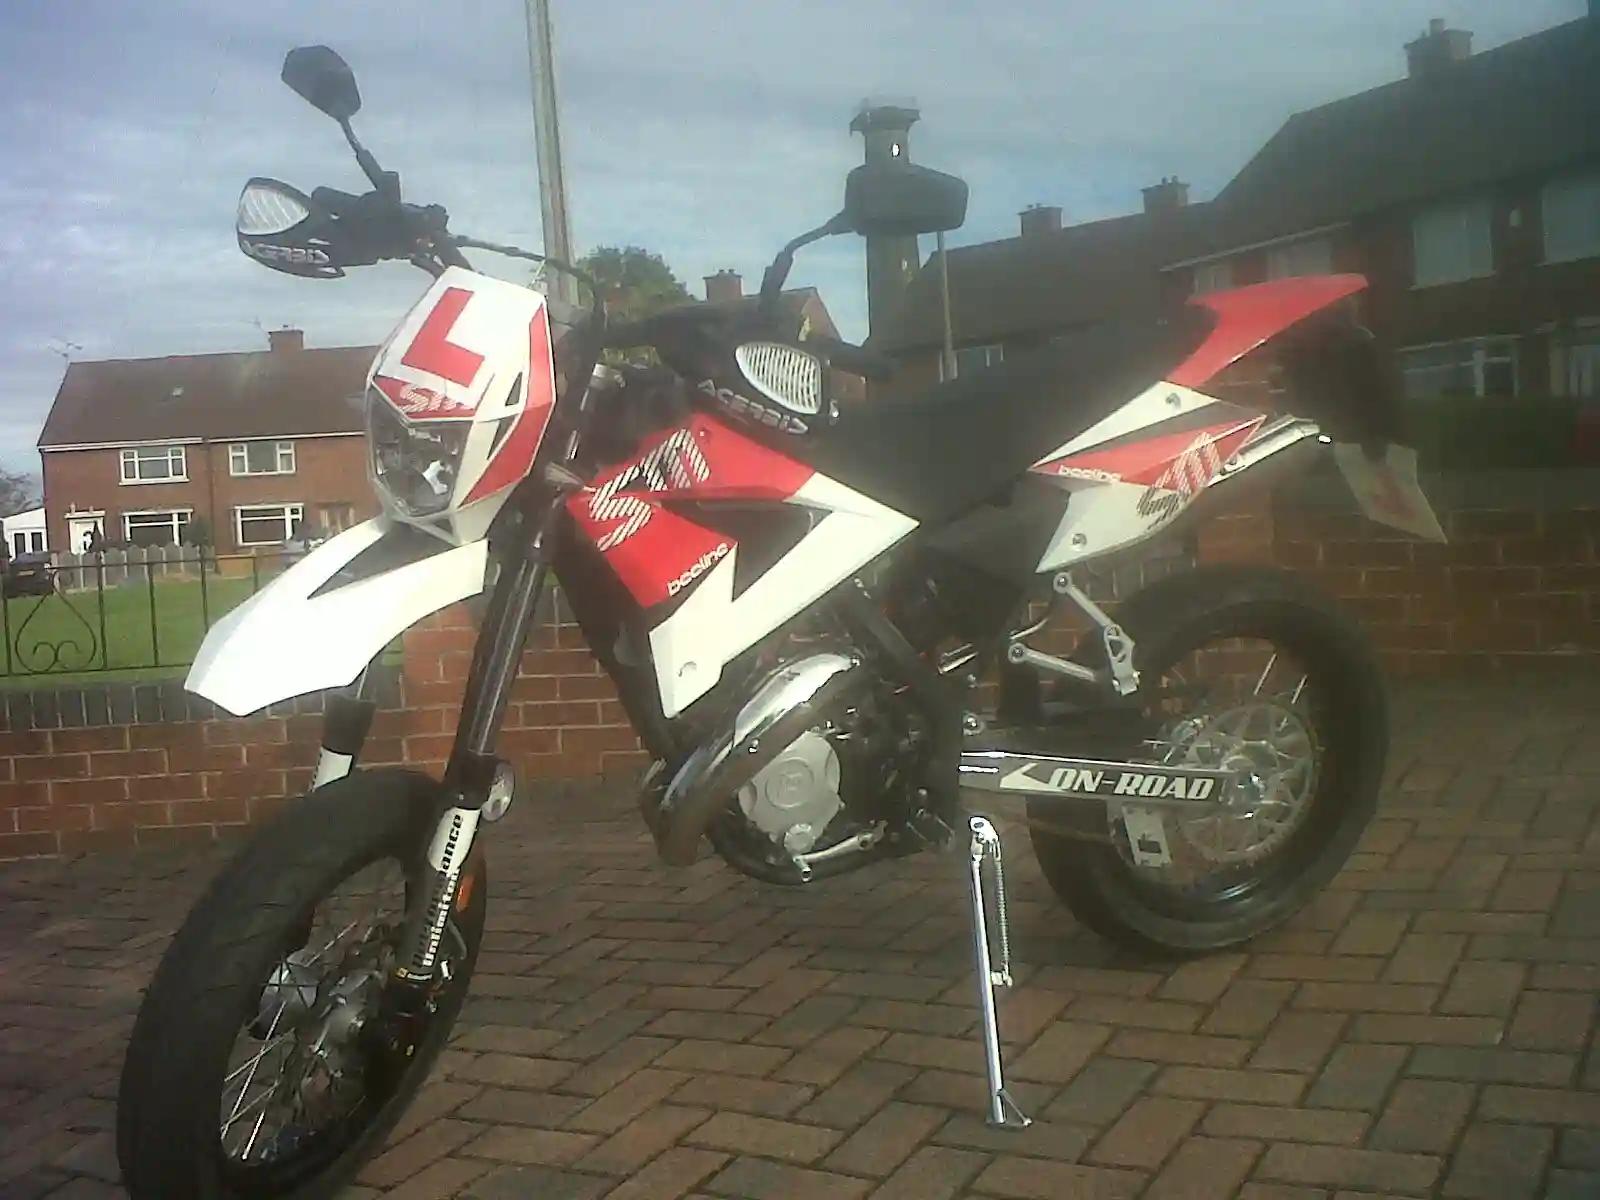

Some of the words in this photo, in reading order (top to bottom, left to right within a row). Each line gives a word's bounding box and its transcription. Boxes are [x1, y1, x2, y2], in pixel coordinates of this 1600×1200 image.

[400, 286, 485, 388] L
[667, 542, 729, 596] beeline
[1049, 767, 1215, 800] ON-ROAD
